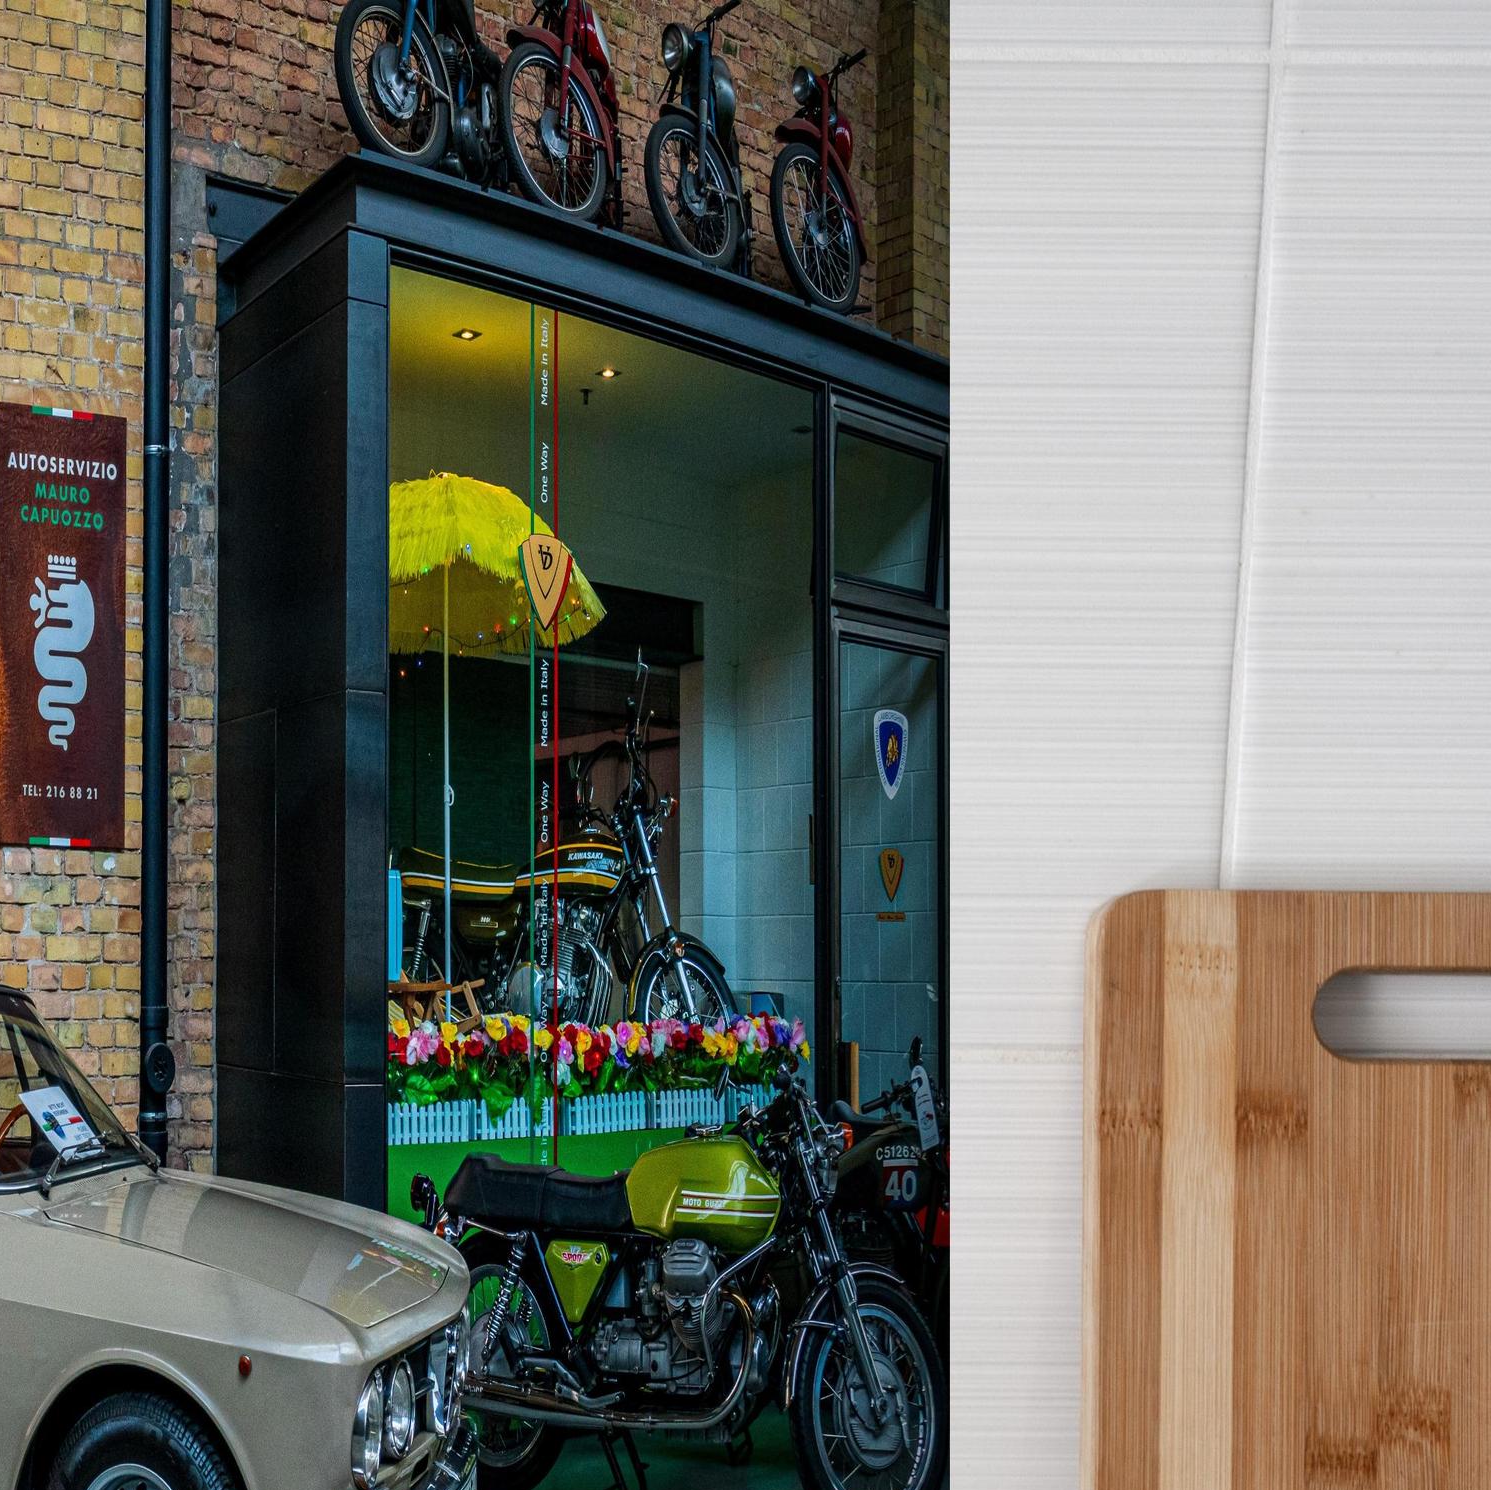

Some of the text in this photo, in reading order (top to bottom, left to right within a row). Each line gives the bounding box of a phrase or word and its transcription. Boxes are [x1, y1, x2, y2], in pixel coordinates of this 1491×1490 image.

[540, 318, 550, 406] Made in Italy
[7, 451, 117, 480] AUTOSERVIZIO
[540, 442, 550, 503] One Way
[34, 482, 90, 504] MAURO
[20, 504, 104, 531] CAPUOZZO
[540, 658, 550, 747] Made in Italy
[22, 784, 98, 800] TEL: 216 88 21
[540, 781, 550, 843] One Way
[568, 851, 604, 861] KAWASAKI
[540, 878, 550, 966] Made in Italy
[540, 1000, 550, 1030] Way
[885, 1170, 917, 1202] 40
[683, 1198, 702, 1207] MOTO
